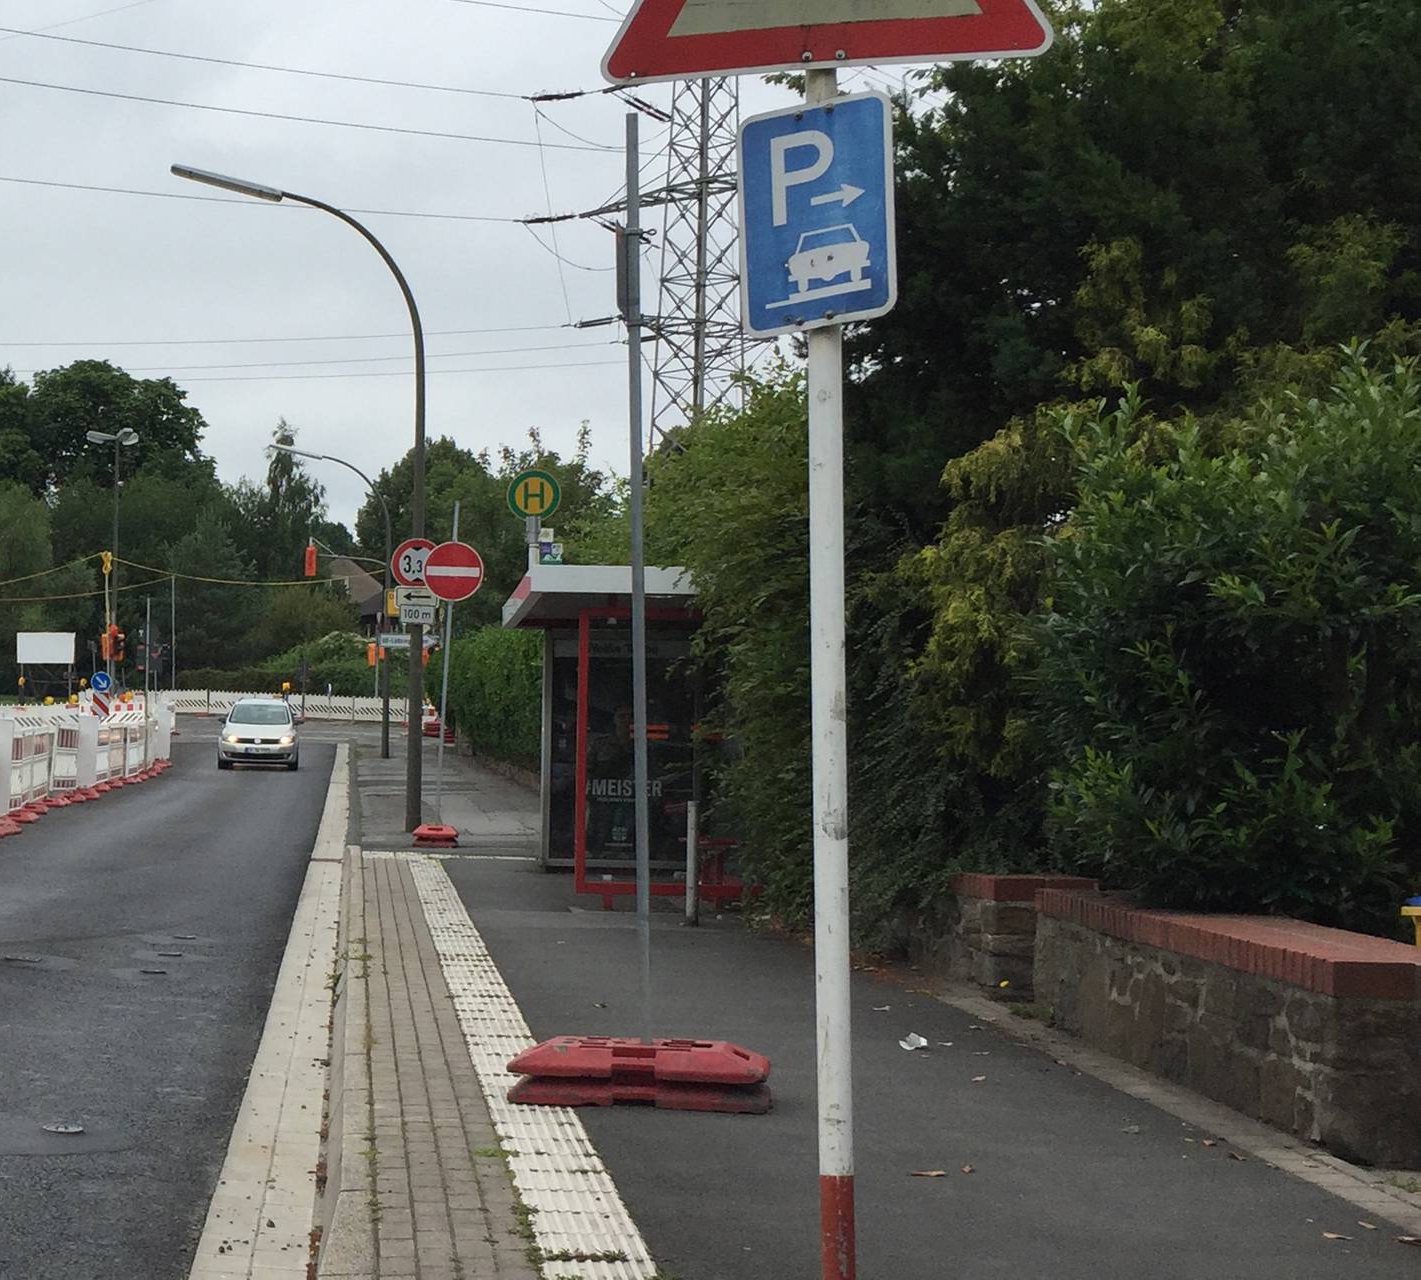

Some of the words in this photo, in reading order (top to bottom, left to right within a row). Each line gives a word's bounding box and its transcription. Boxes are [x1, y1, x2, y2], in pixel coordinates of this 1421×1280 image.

[770, 130, 834, 227] P
[523, 481, 545, 509] H
[404, 609, 420, 619] 100
[421, 611, 431, 619] m
